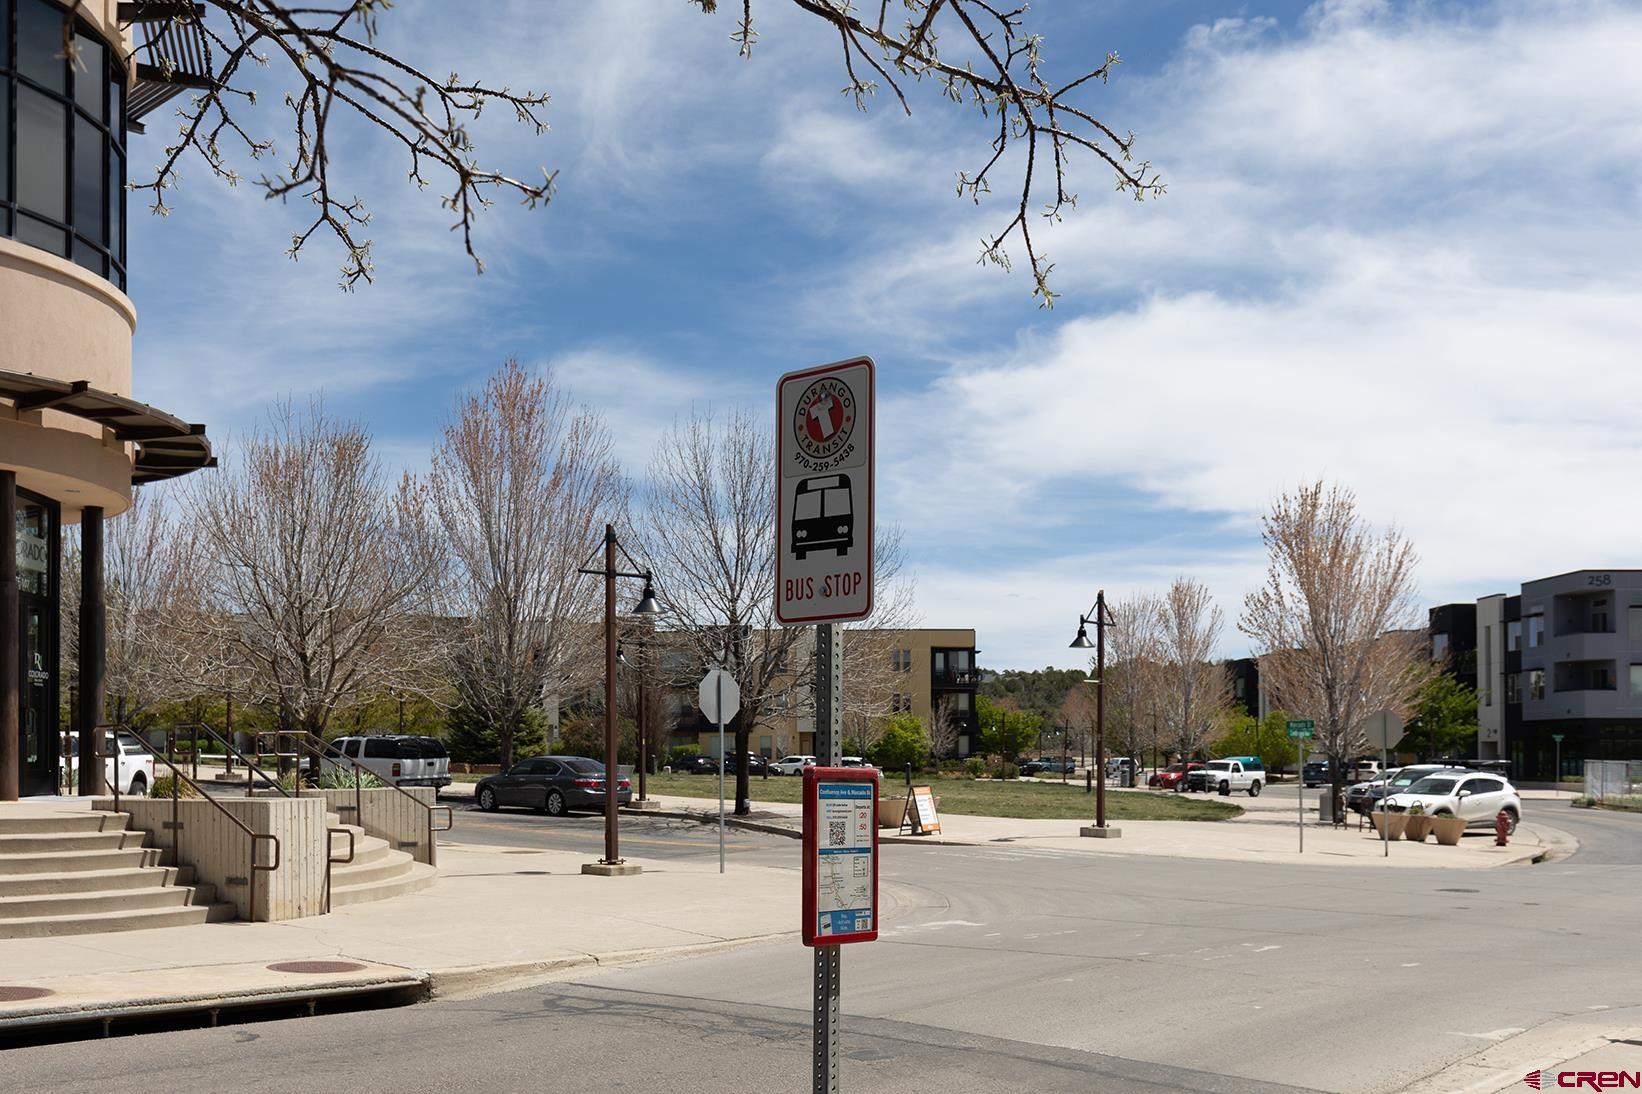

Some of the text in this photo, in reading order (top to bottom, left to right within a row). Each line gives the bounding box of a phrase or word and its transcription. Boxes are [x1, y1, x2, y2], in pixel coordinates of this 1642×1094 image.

[799, 382, 851, 416] DURANGO
[801, 427, 848, 454] TRANSIT
[794, 443, 855, 472] 970-259-5438
[785, 572, 862, 601] BUS STOP
[1588, 574, 1611, 587] 258
